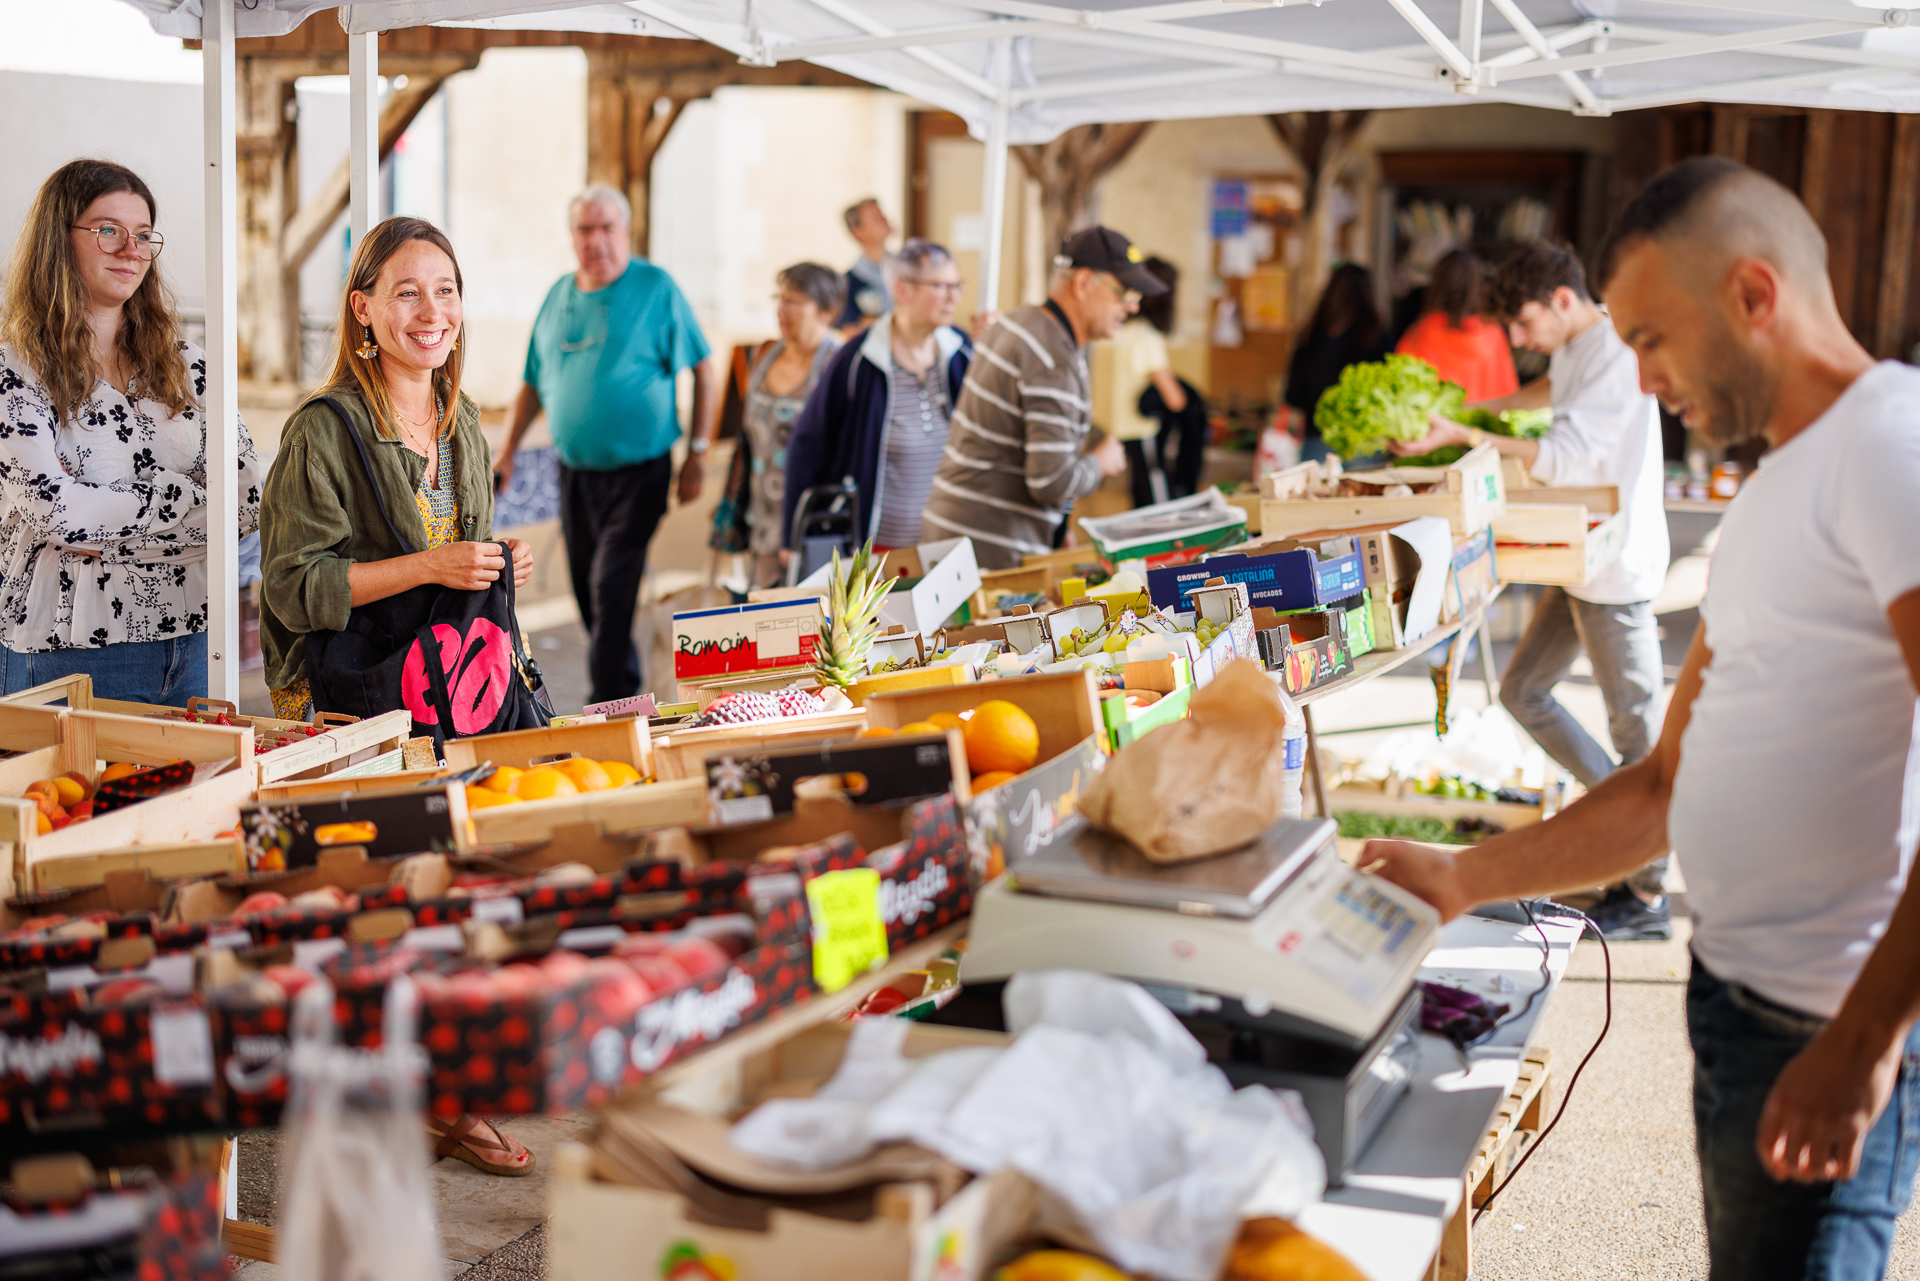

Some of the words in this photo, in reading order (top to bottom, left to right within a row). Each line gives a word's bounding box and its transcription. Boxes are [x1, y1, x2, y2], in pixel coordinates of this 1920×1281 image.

[1177, 571, 1210, 582] GROWING
[1231, 568, 1275, 584] CATALINA
[1252, 589, 1283, 599] AVOCADOS
[677, 632, 751, 657] Romain
